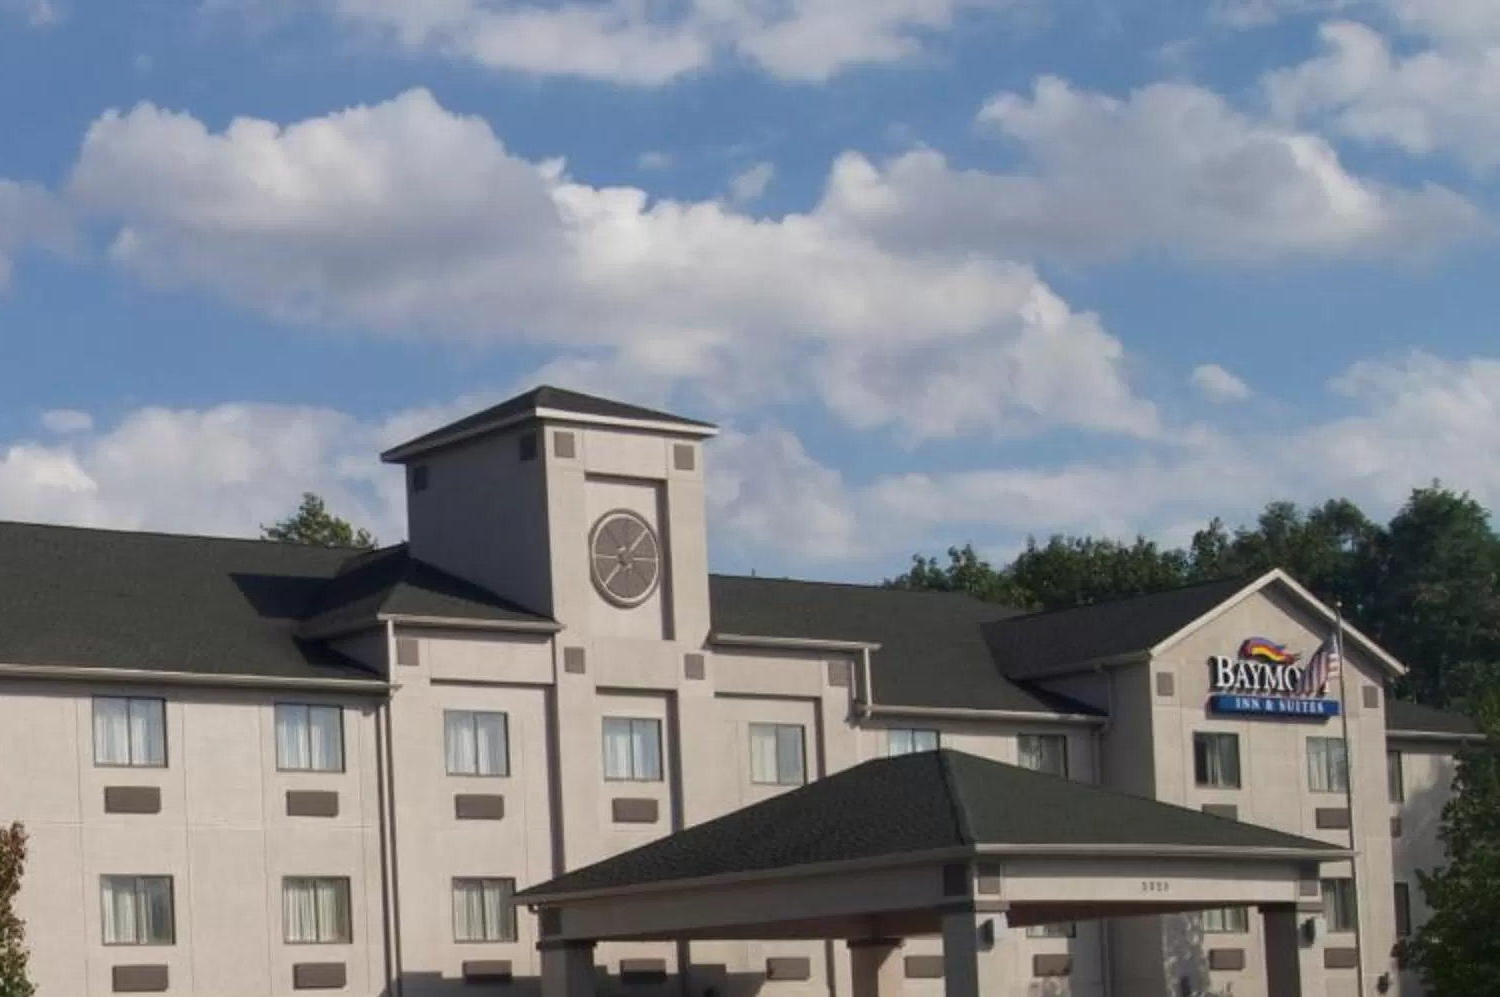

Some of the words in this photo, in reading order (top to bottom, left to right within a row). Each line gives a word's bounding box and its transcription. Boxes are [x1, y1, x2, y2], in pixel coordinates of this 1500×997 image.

[1216, 655, 1332, 693] BAYMO
[1235, 697, 1260, 710] INN
[1265, 698, 1275, 712] &
[1278, 699, 1325, 713] SUITES
